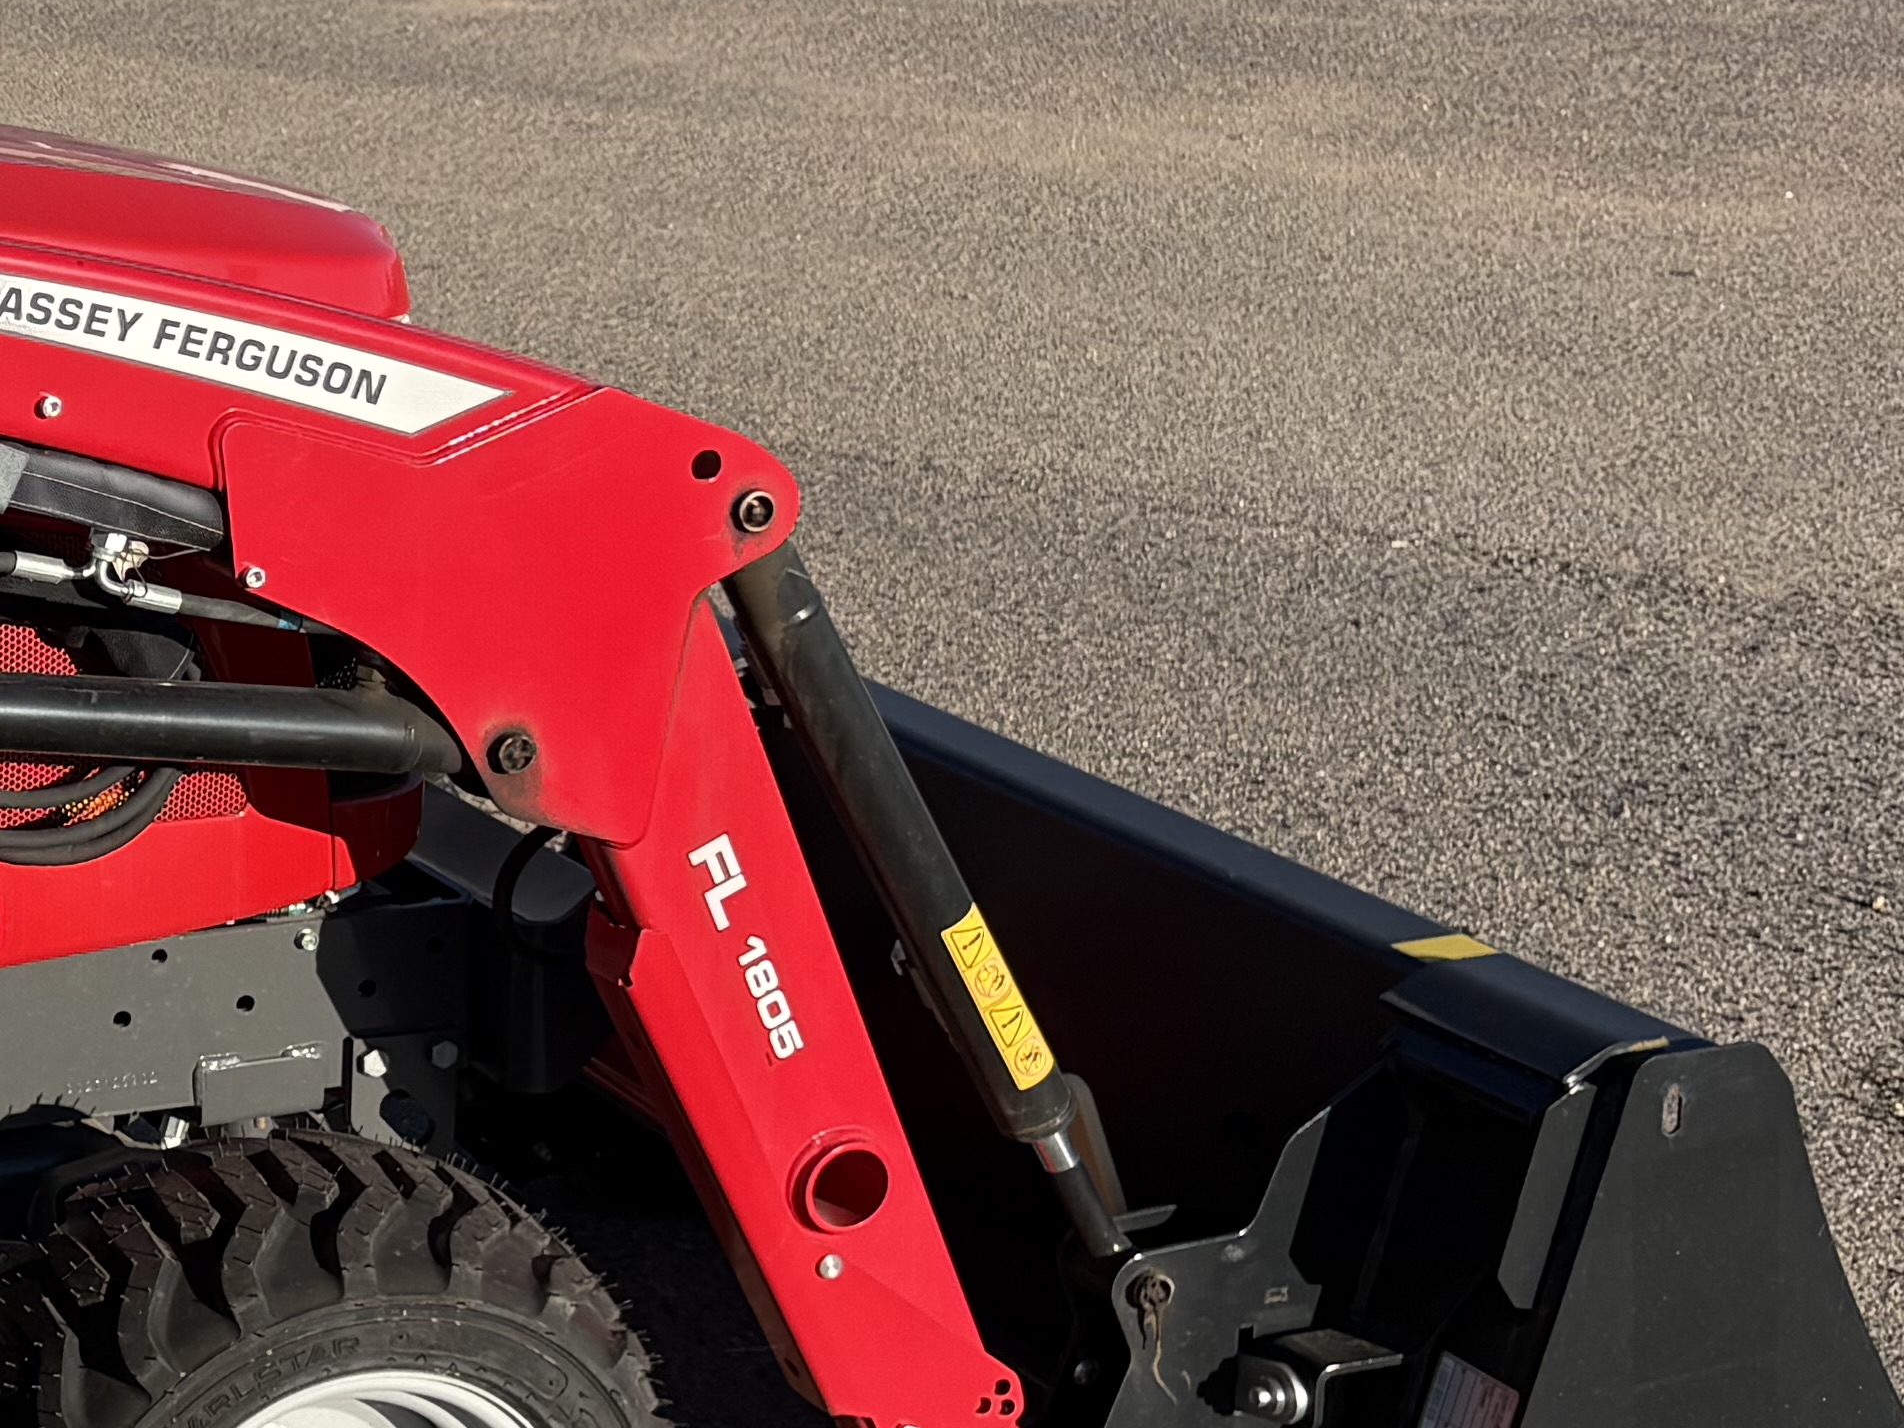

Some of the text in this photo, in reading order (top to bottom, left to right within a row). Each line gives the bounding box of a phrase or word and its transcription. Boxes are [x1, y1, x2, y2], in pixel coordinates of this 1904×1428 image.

[152, 318, 389, 408] FERGUSON
[688, 832, 804, 1060] FL 1805
